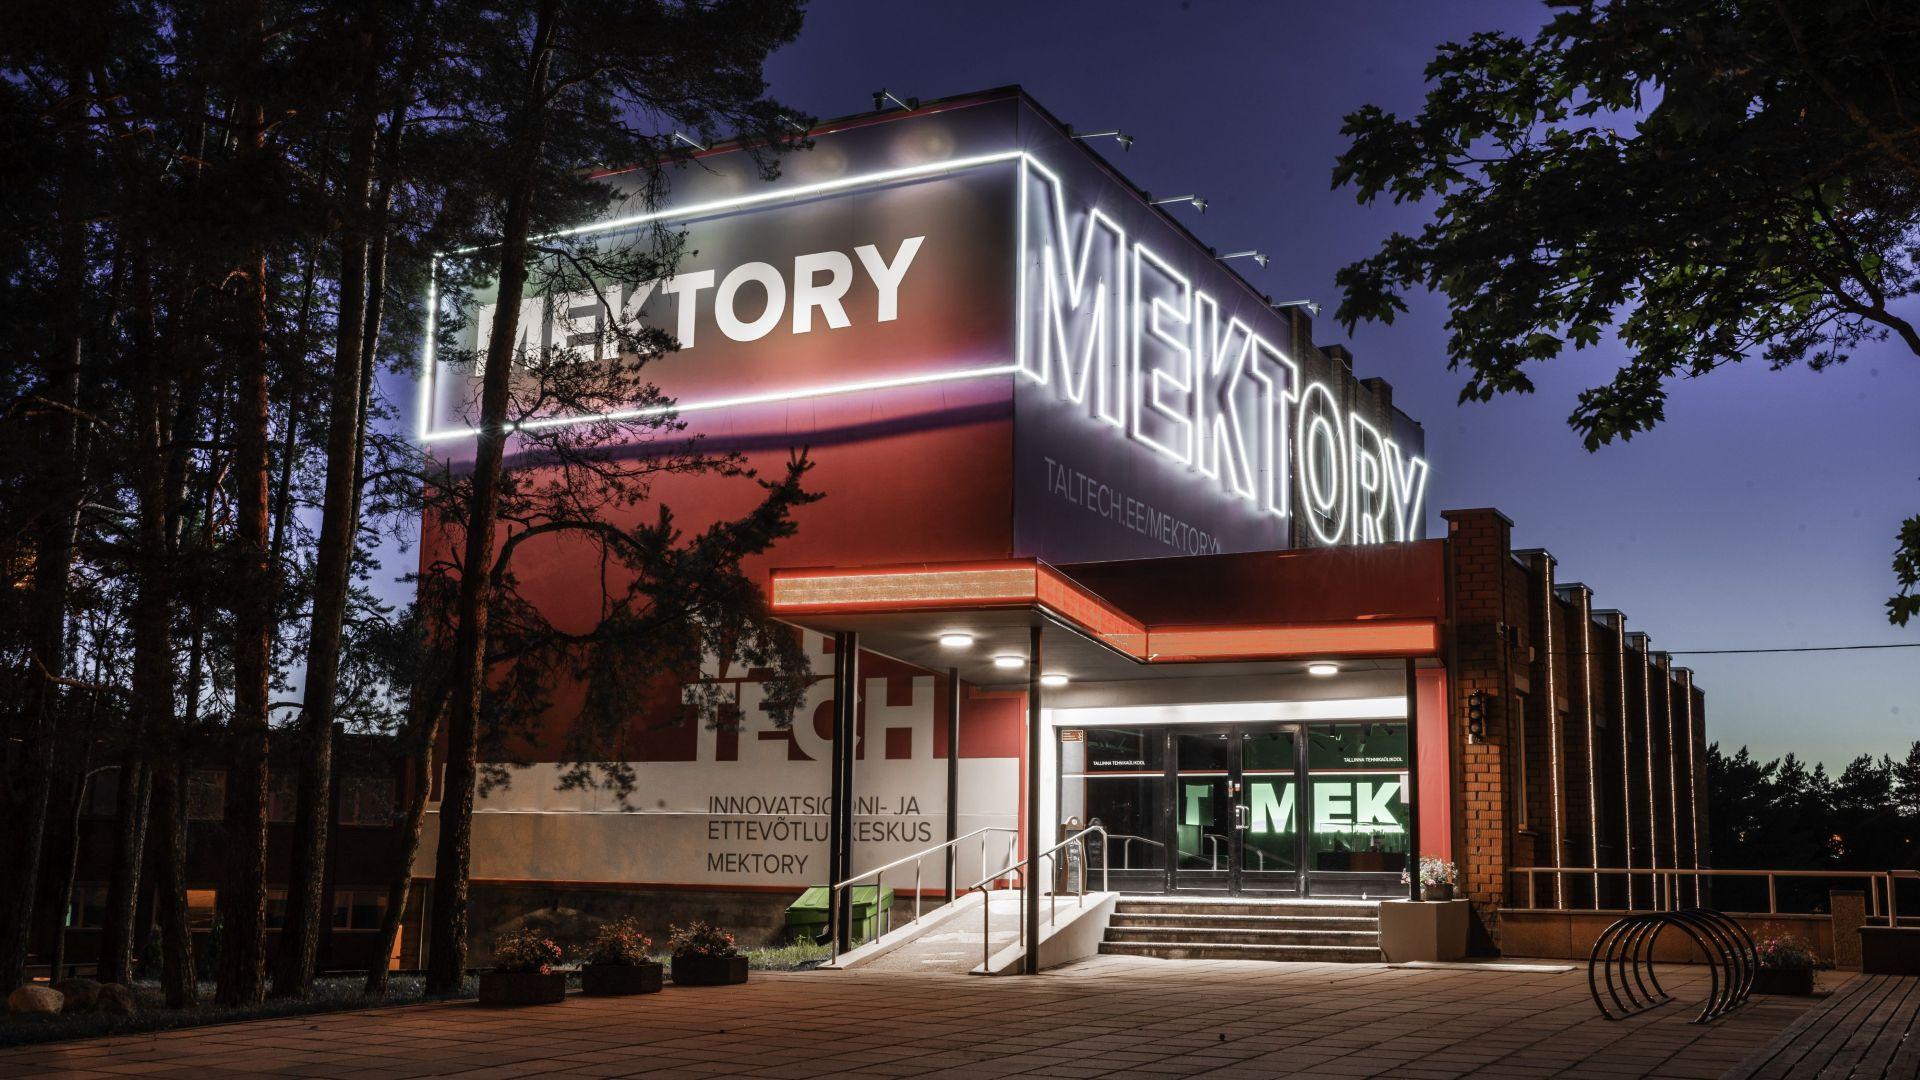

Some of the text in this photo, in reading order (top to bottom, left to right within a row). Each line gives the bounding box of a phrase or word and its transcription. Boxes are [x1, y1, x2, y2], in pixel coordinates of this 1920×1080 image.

[475, 236, 925, 377] MEKTORY
[1019, 151, 1428, 546] MEKTORY
[1044, 456, 1217, 556] TALTECH.EE/MEKTORY
[681, 675, 935, 761] TECH
[893, 796, 921, 815] JA
[706, 853, 809, 875] MEKTORY
